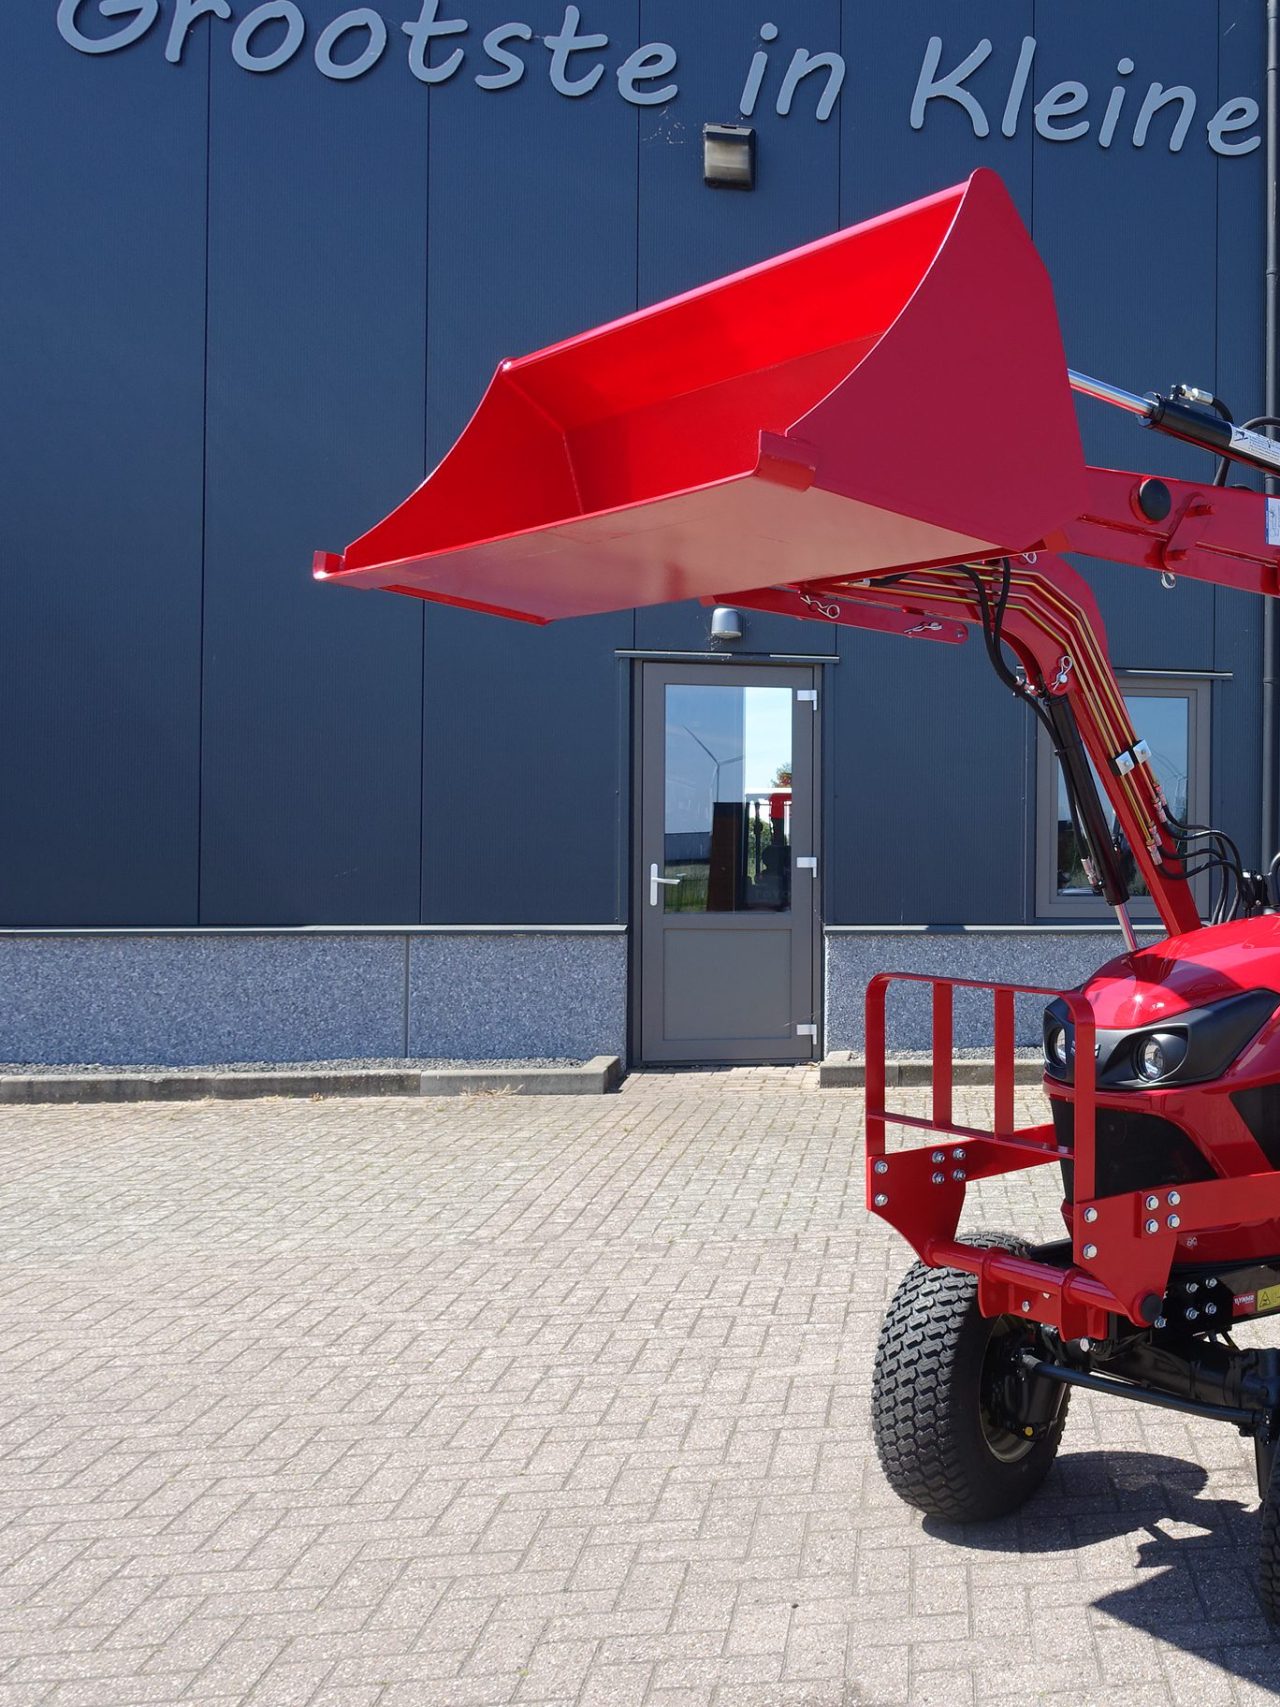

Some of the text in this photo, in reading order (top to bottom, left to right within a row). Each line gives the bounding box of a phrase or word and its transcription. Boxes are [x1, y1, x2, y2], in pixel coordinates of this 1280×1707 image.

[57, 0, 679, 105] Grootste
[739, 22, 847, 121] in
[910, 36, 1262, 156] Kleine
